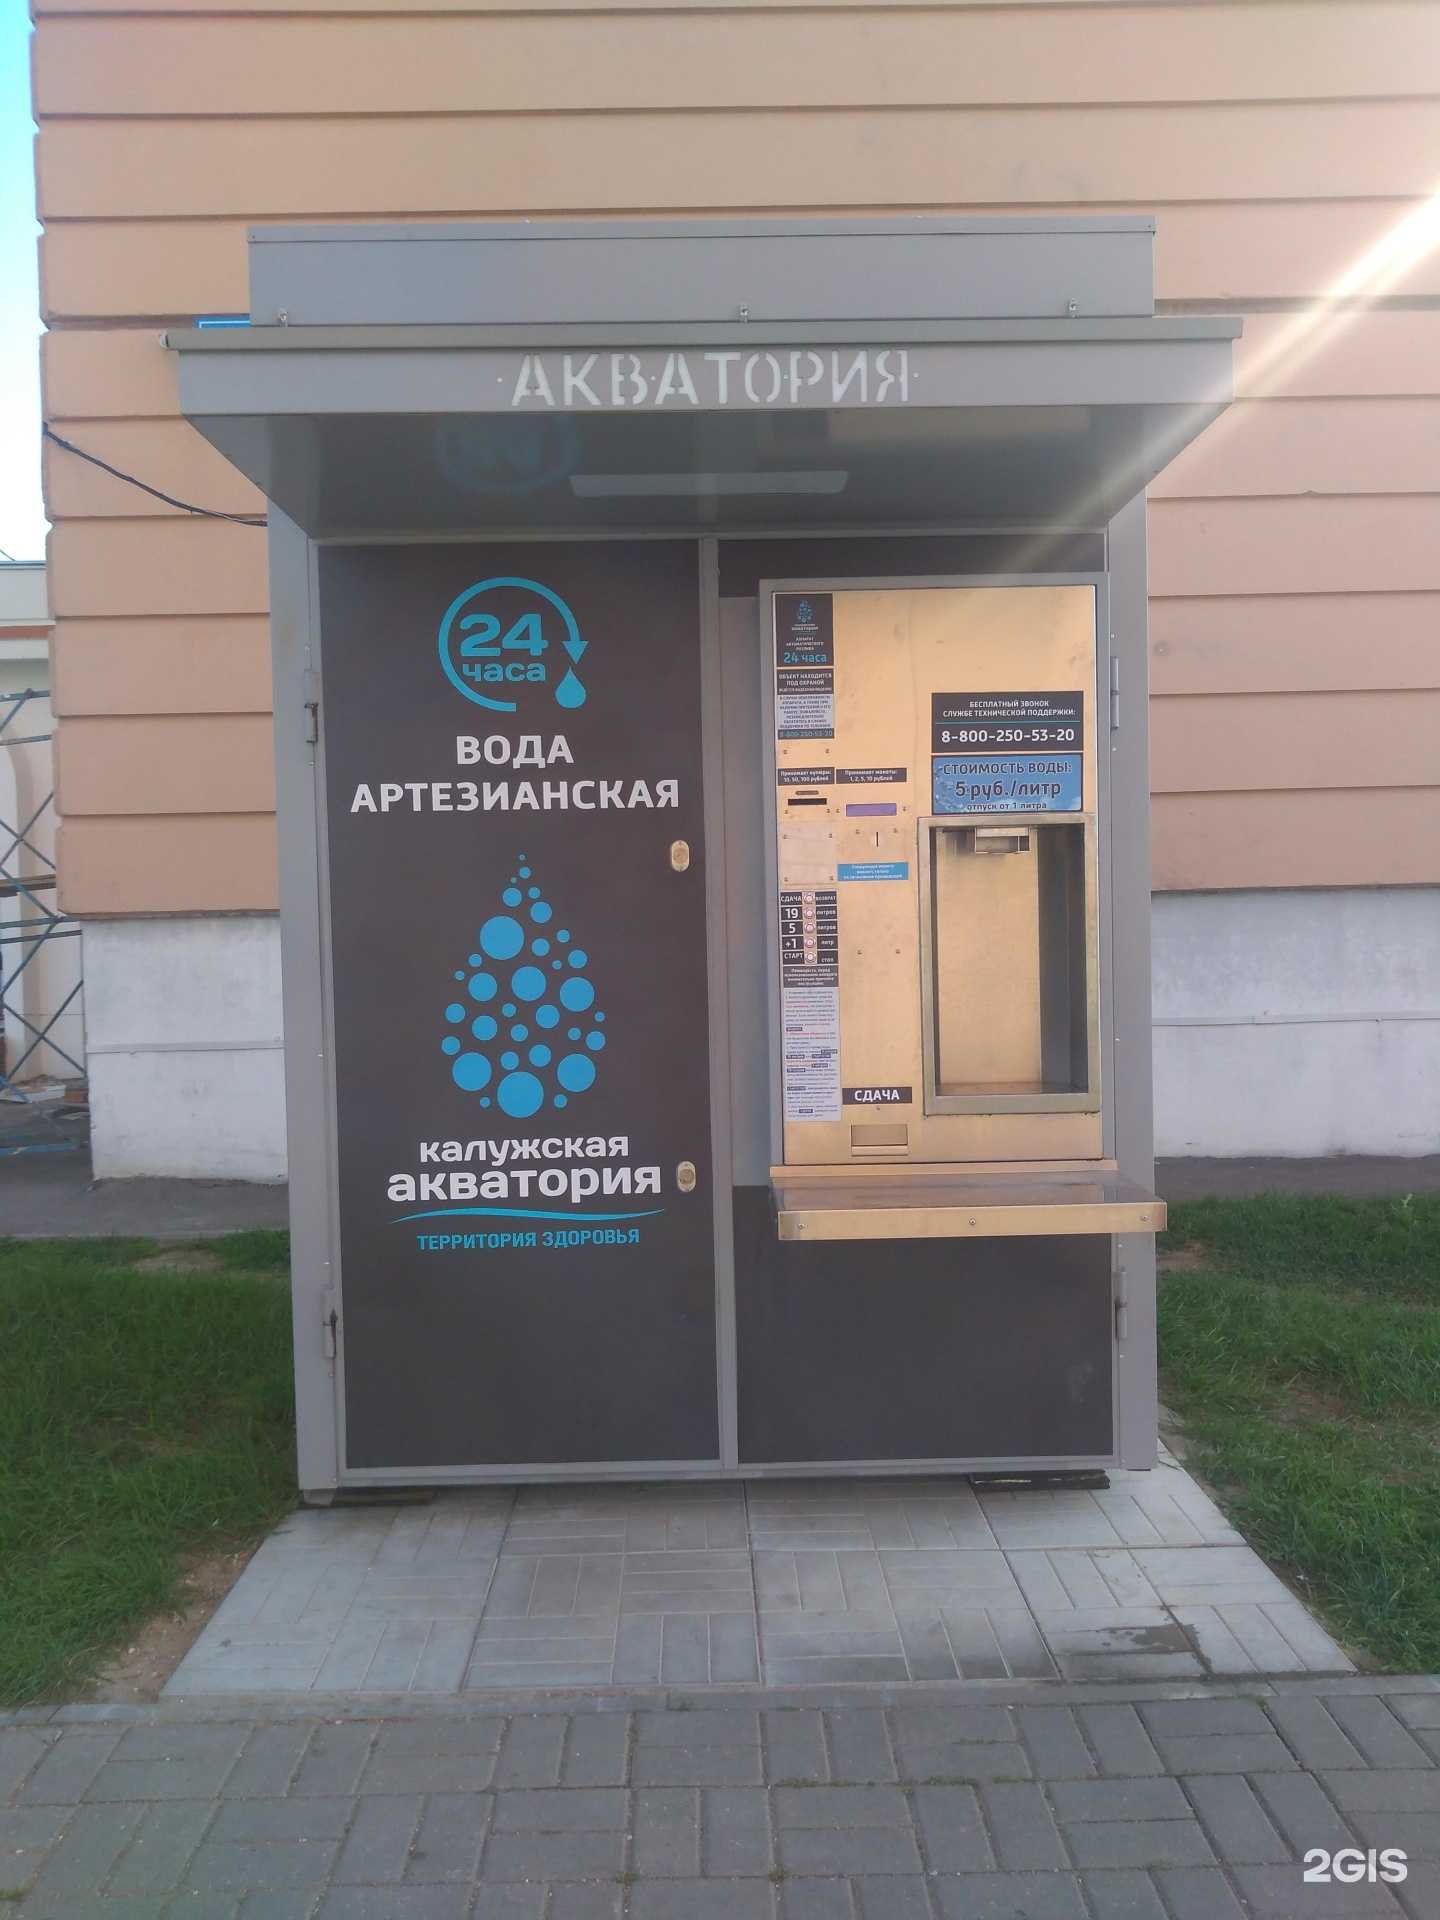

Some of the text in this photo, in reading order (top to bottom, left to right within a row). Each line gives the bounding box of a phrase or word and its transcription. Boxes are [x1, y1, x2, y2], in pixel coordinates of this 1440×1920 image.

[510, 349, 909, 409] АКВАТОРИЯ
[459, 613, 548, 657] 24
[783, 652, 827, 664] 24 часа
[463, 662, 546, 682] часа
[969, 700, 1019, 708] БЕСПЛАТНЫЙ
[942, 708, 1076, 718] СЛУЖБЕ ТЕХНИЧЕСКОЙ ПОДДЕРЖКИ:
[941, 728, 1075, 743] 8-800-250-53-20
[456, 734, 574, 768] ВОДА
[943, 761, 1072, 775] СТОИМОСТЬ ВОДЫ:
[350, 779, 679, 813] АРТЕЗИАНСКАЯ
[955, 780, 1061, 800] 5 руб./литр
[967, 803, 997, 812] отпуск
[1020, 802, 1047, 811] литра
[785, 908, 799, 919] 19
[788, 923, 796, 933] 5
[785, 938, 797, 949] +1
[854, 1089, 900, 1102] СДАЧА
[419, 1135, 629, 1166] калужская
[387, 1165, 661, 1203] акватория
[416, 1228, 640, 1250] ТЕРРИТОРИЯ ЗДОРОВЬЯ
